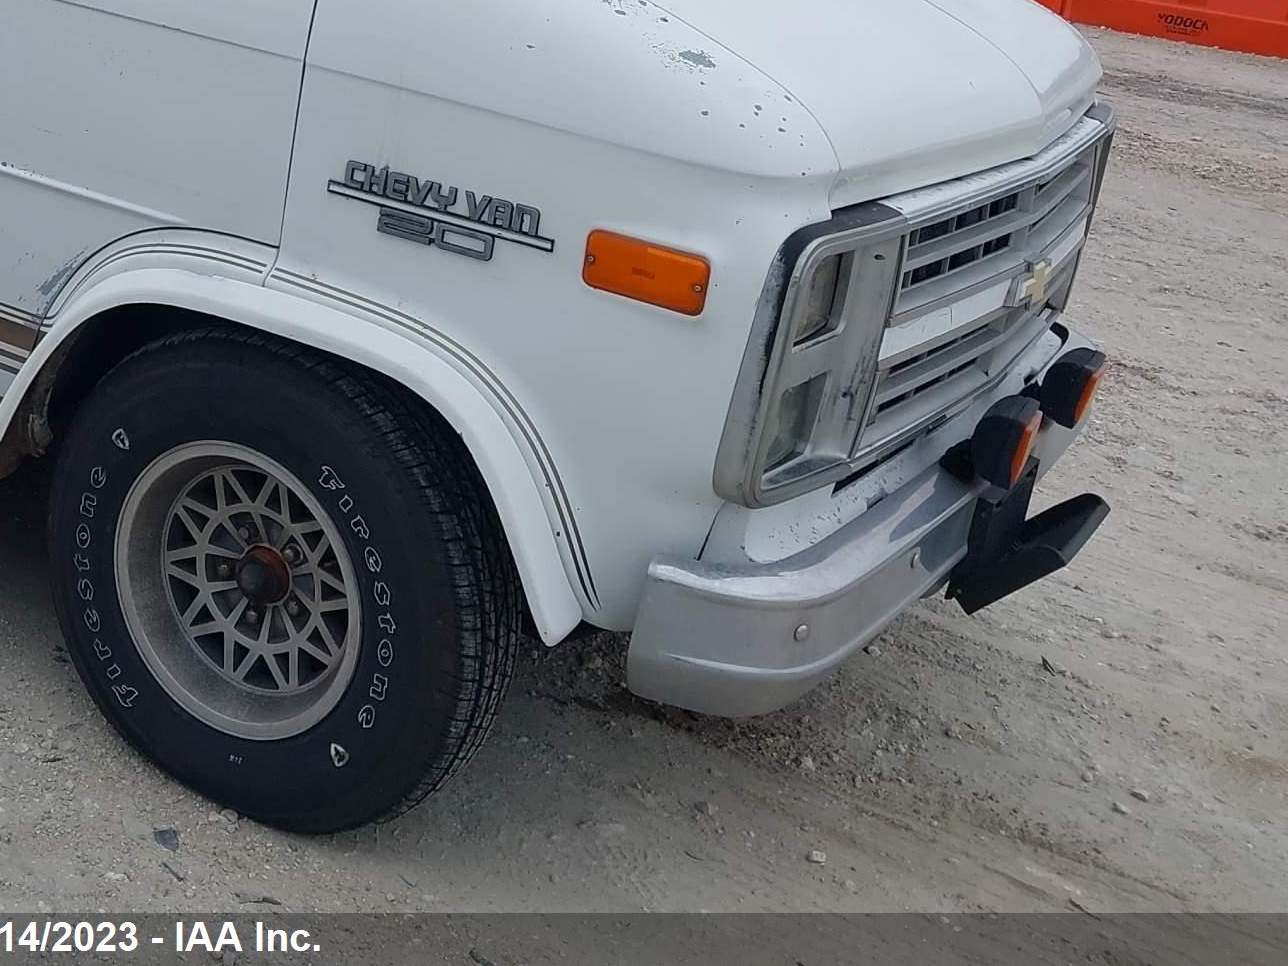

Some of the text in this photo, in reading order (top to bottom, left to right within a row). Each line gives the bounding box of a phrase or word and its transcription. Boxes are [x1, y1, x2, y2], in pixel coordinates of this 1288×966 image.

[344, 160, 541, 235] CHEVY VAN
[377, 207, 495, 261] 20
[73, 466, 139, 708] Firestone
[318, 465, 396, 728] Firestone
